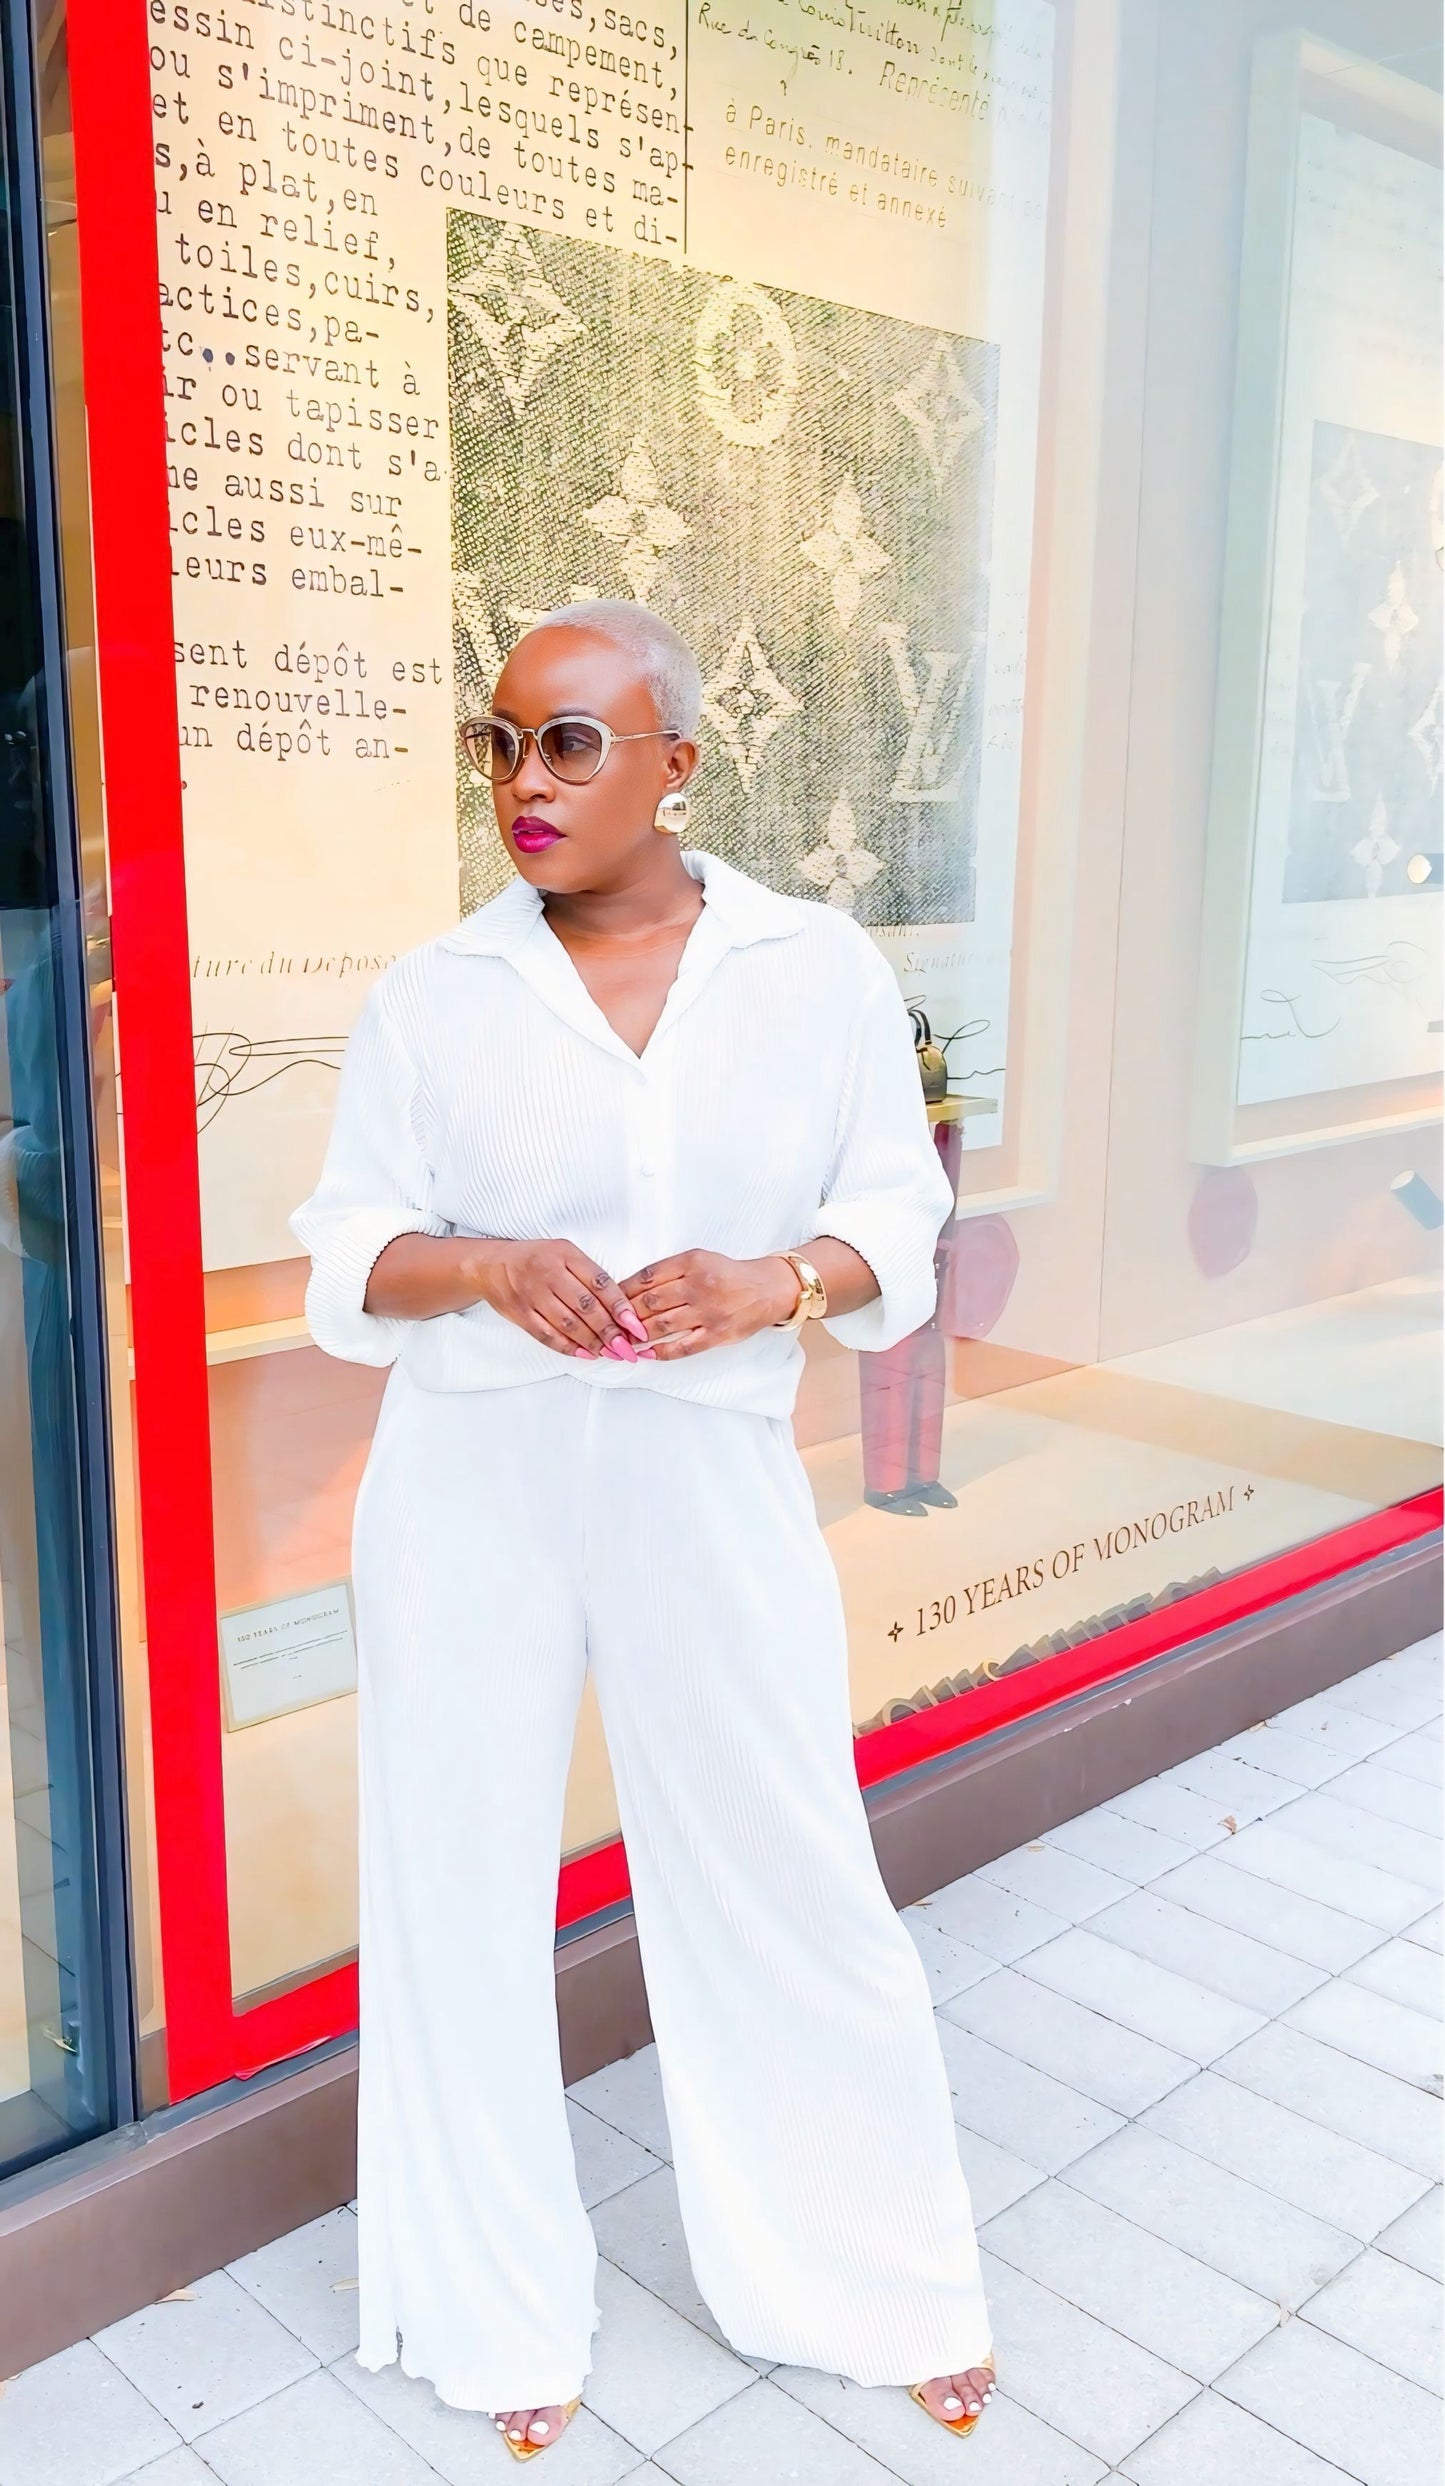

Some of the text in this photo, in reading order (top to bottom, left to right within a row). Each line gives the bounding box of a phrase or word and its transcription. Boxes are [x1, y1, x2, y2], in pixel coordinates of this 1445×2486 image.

[459, 0, 677, 101] de campement,
[477, 56, 528, 86] que
[549, 75, 694, 133] représen-
[150, 46, 190, 78] ou
[514, 141, 615, 193] toutes
[632, 179, 678, 206] ma-
[152, 92, 678, 245] et en toutes couleurs et di-
[619, 136, 694, 178] s'ap-
[825, 135, 938, 188] mandataire
[725, 145, 947, 228] enregistré et annexé
[198, 199, 237, 228] en
[260, 214, 395, 269] relief,
[403, 360, 420, 395] à
[222, 384, 262, 411] ou
[286, 389, 439, 439] tapisser
[287, 433, 362, 470] dont
[225, 474, 325, 508] aussi
[351, 490, 402, 517] sur
[170, 505, 422, 558] cles eux-mê-
[171, 555, 404, 598] eurs embal-
[274, 641, 368, 683] dépôt
[392, 658, 443, 685] est
[190, 684, 406, 720] renouvelle-
[236, 718, 331, 762] dépôt
[355, 738, 409, 759] an-
[915, 1594, 957, 1637] 130
[963, 1558, 1045, 1617] YEARS
[1051, 1542, 1086, 1580] OF
[1093, 1484, 1235, 1562] MONOGRAM
